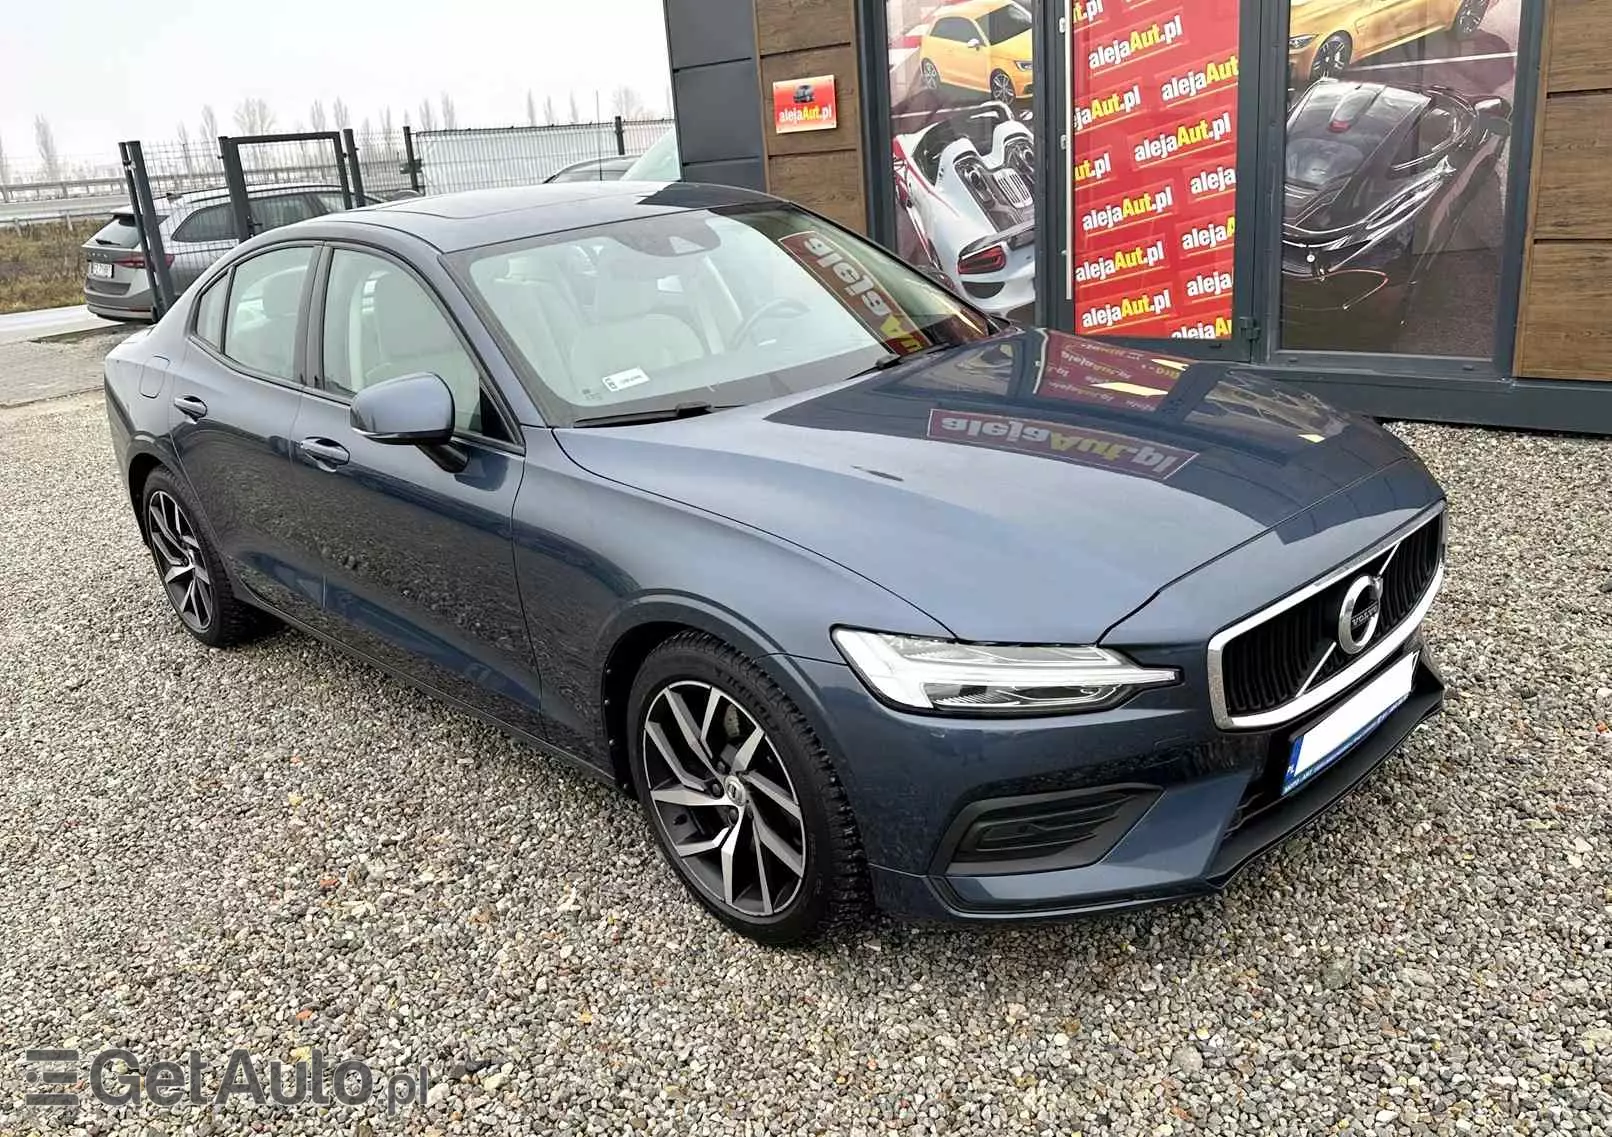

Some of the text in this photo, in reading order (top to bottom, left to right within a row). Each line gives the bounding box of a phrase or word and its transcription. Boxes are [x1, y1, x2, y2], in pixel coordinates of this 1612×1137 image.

[1088, 15, 1183, 69] alejaAut.pl
[1160, 55, 1239, 101] alejaAut
[778, 103, 832, 124] alejaAut.pl
[1134, 112, 1232, 162] alejaAut.pl
[1190, 166, 1236, 194] aleja
[1082, 186, 1173, 231] alejaAut.pl
[1075, 241, 1165, 282] alejaAut.pl
[1082, 289, 1172, 328] alejaAut.pl
[1351, 604, 1378, 626] VOLVO
